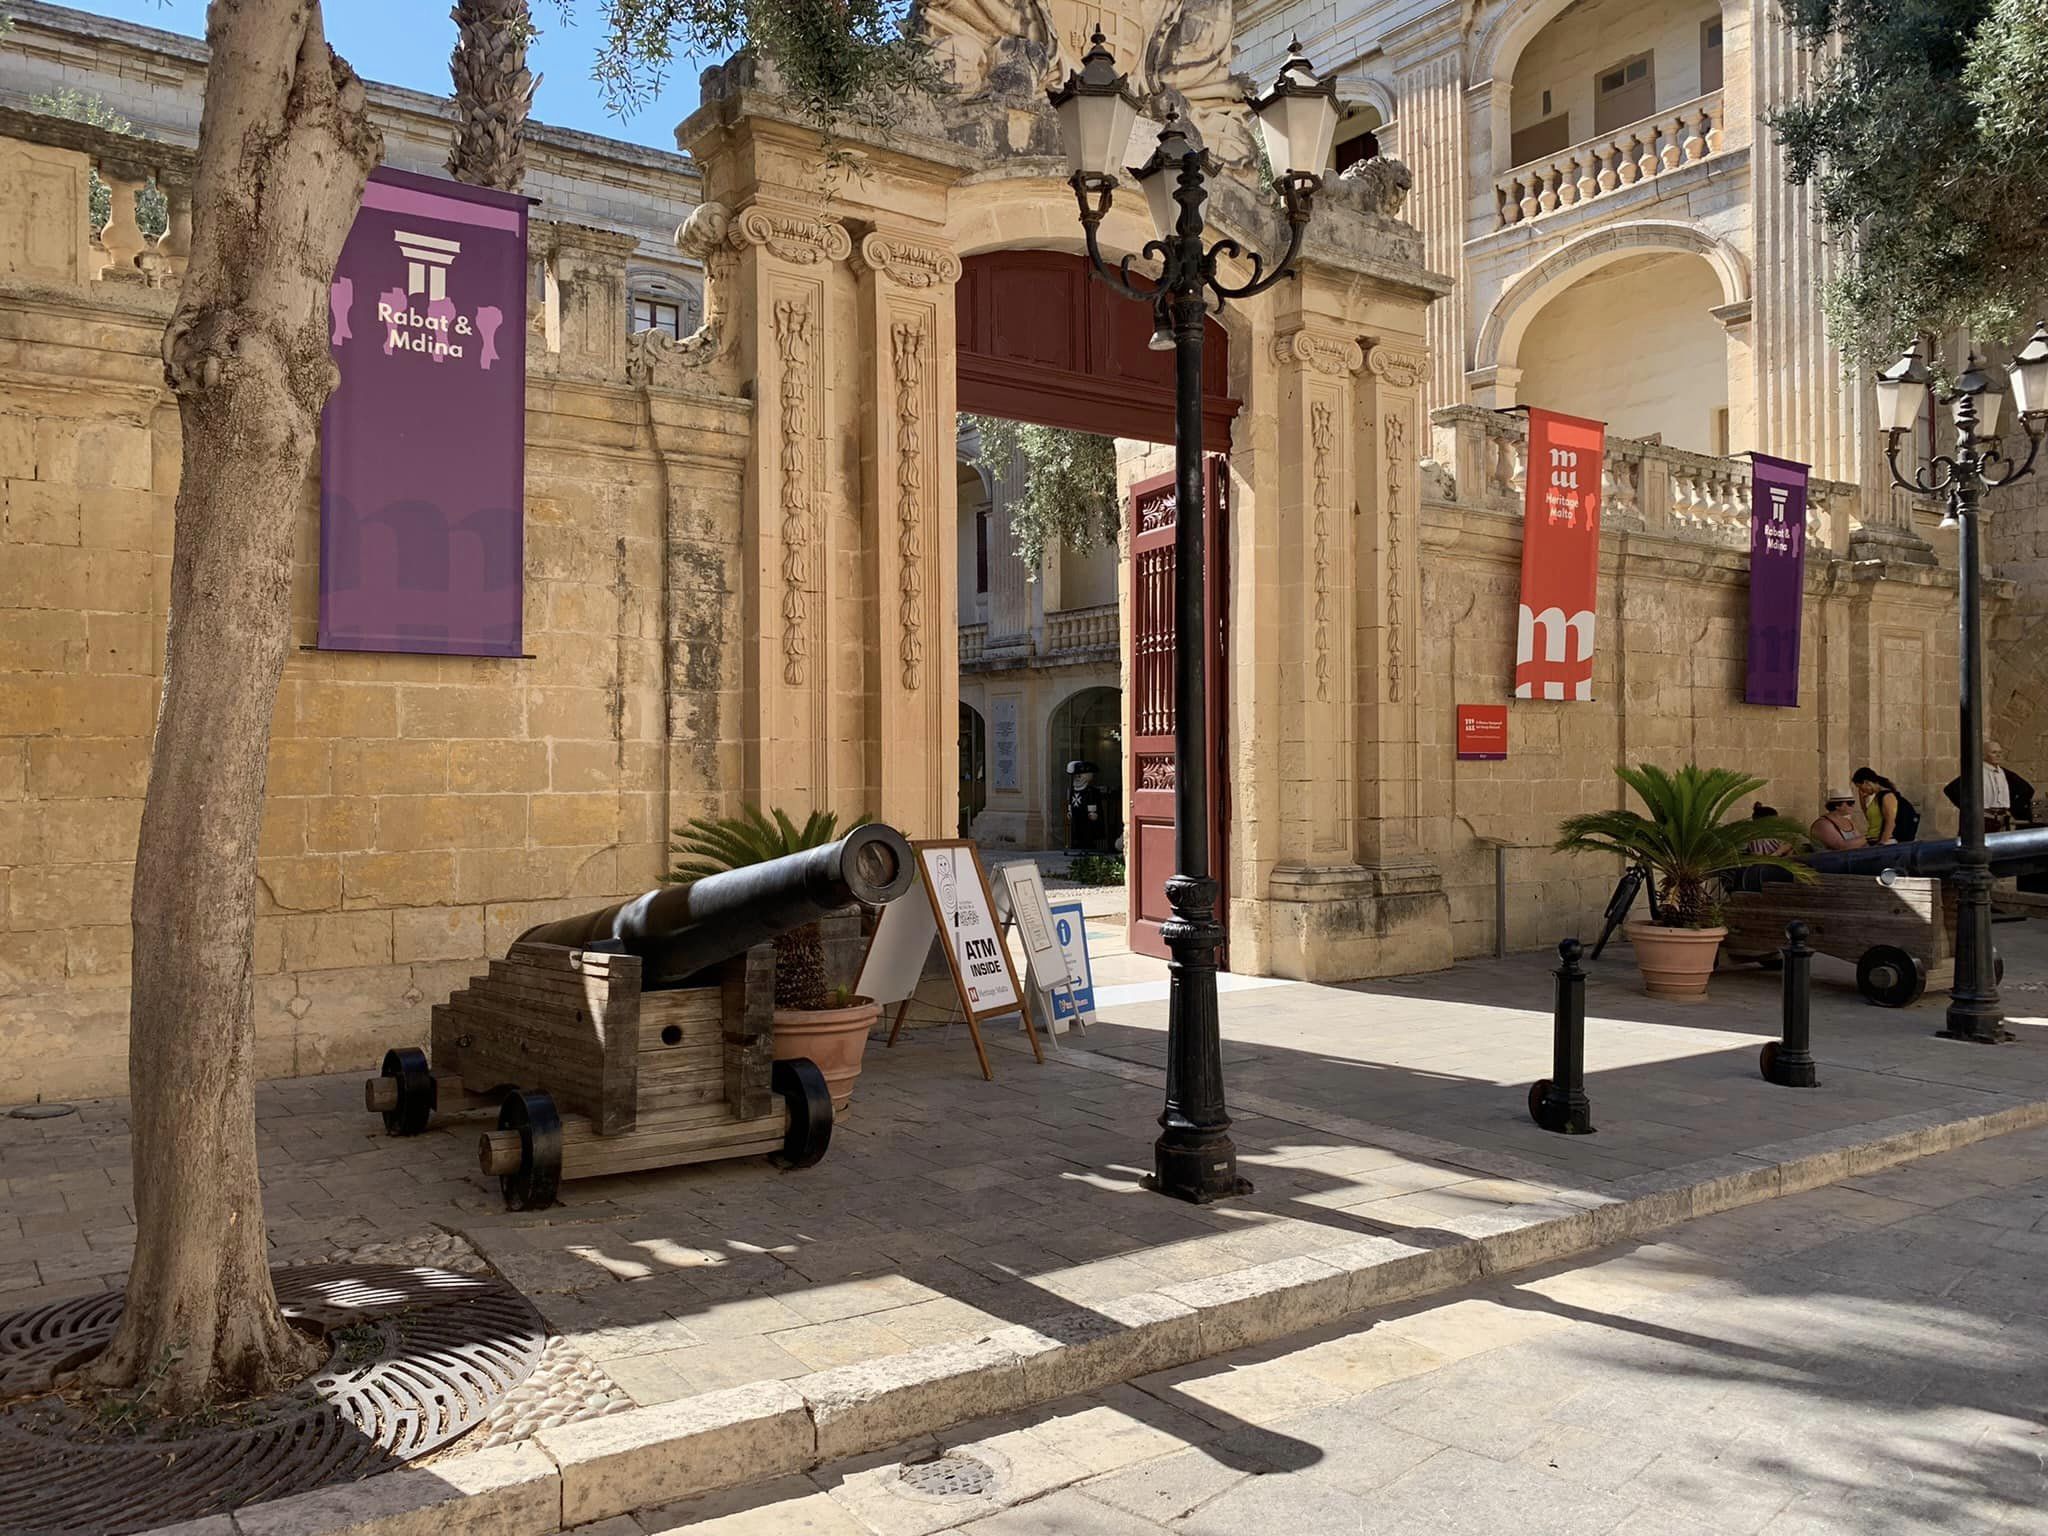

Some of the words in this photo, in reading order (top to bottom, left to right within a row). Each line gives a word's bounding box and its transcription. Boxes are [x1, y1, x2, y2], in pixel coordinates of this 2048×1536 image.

[378, 302, 449, 332] Rabat
[454, 315, 473, 336] &
[389, 328, 463, 358] Mdina
[1545, 492, 1579, 508] Heritage
[1550, 506, 1574, 520] Malta
[1764, 523, 1785, 538] Rabat
[1767, 537, 1788, 551] Mdina
[965, 938, 997, 960] ATM
[970, 960, 1002, 977] INSIDE
